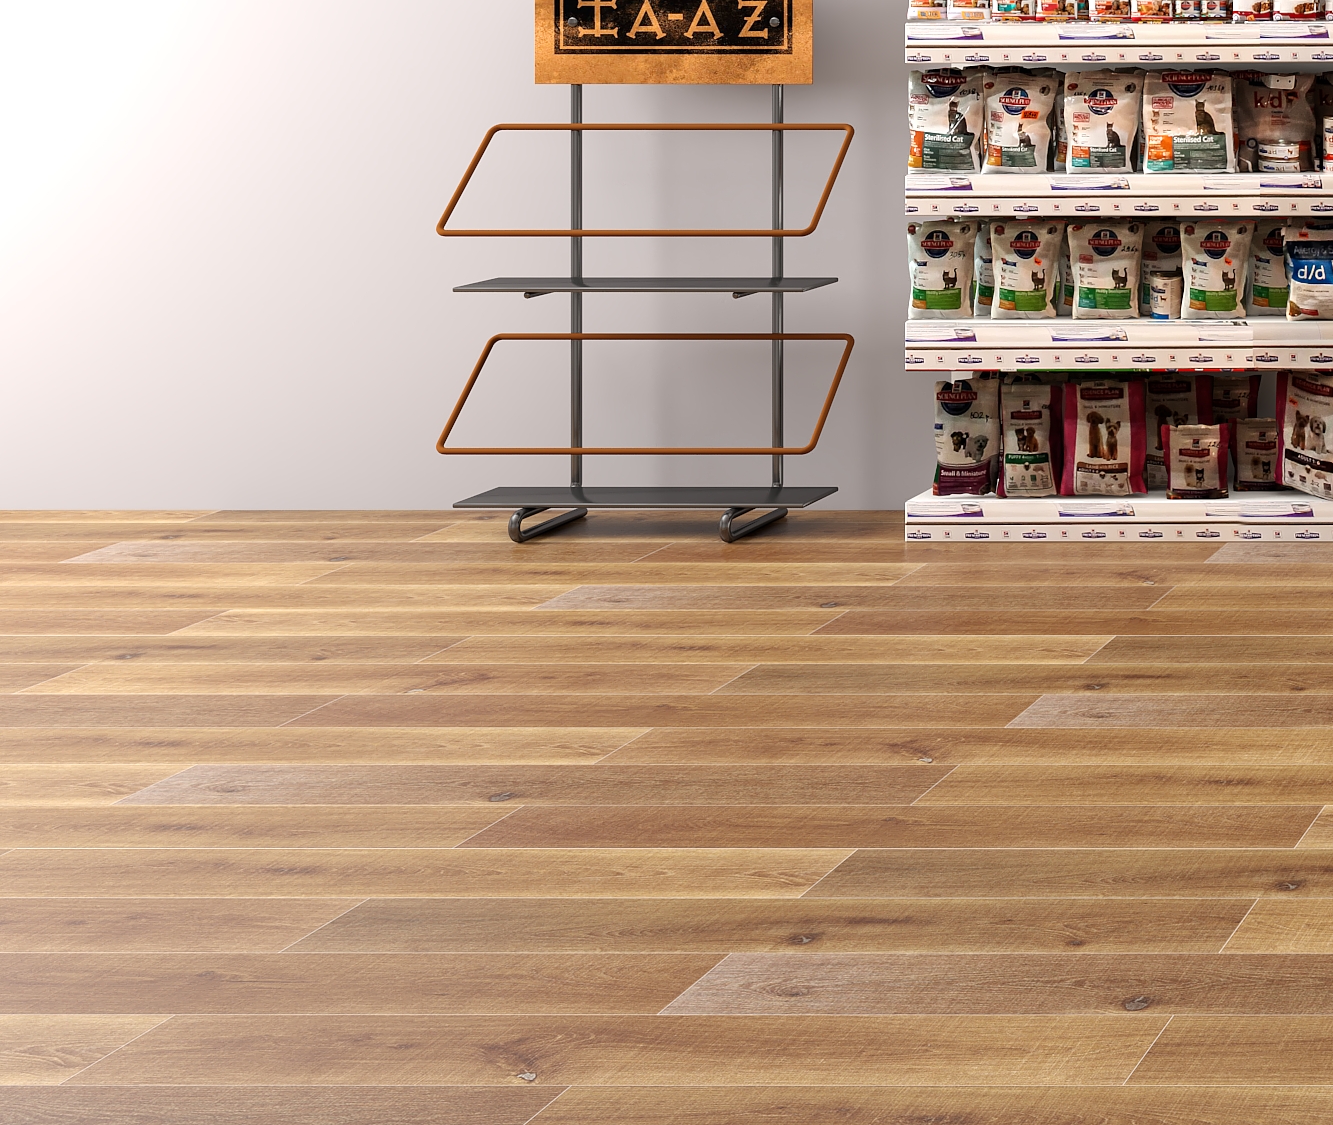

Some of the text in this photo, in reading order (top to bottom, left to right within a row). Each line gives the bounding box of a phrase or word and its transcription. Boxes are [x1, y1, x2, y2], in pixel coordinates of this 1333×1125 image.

[1254, 91, 1282, 109] k/d
[1294, 245, 1320, 256] Allergy
[1297, 264, 1326, 280] d/d
[1297, 454, 1312, 464] ADULT
